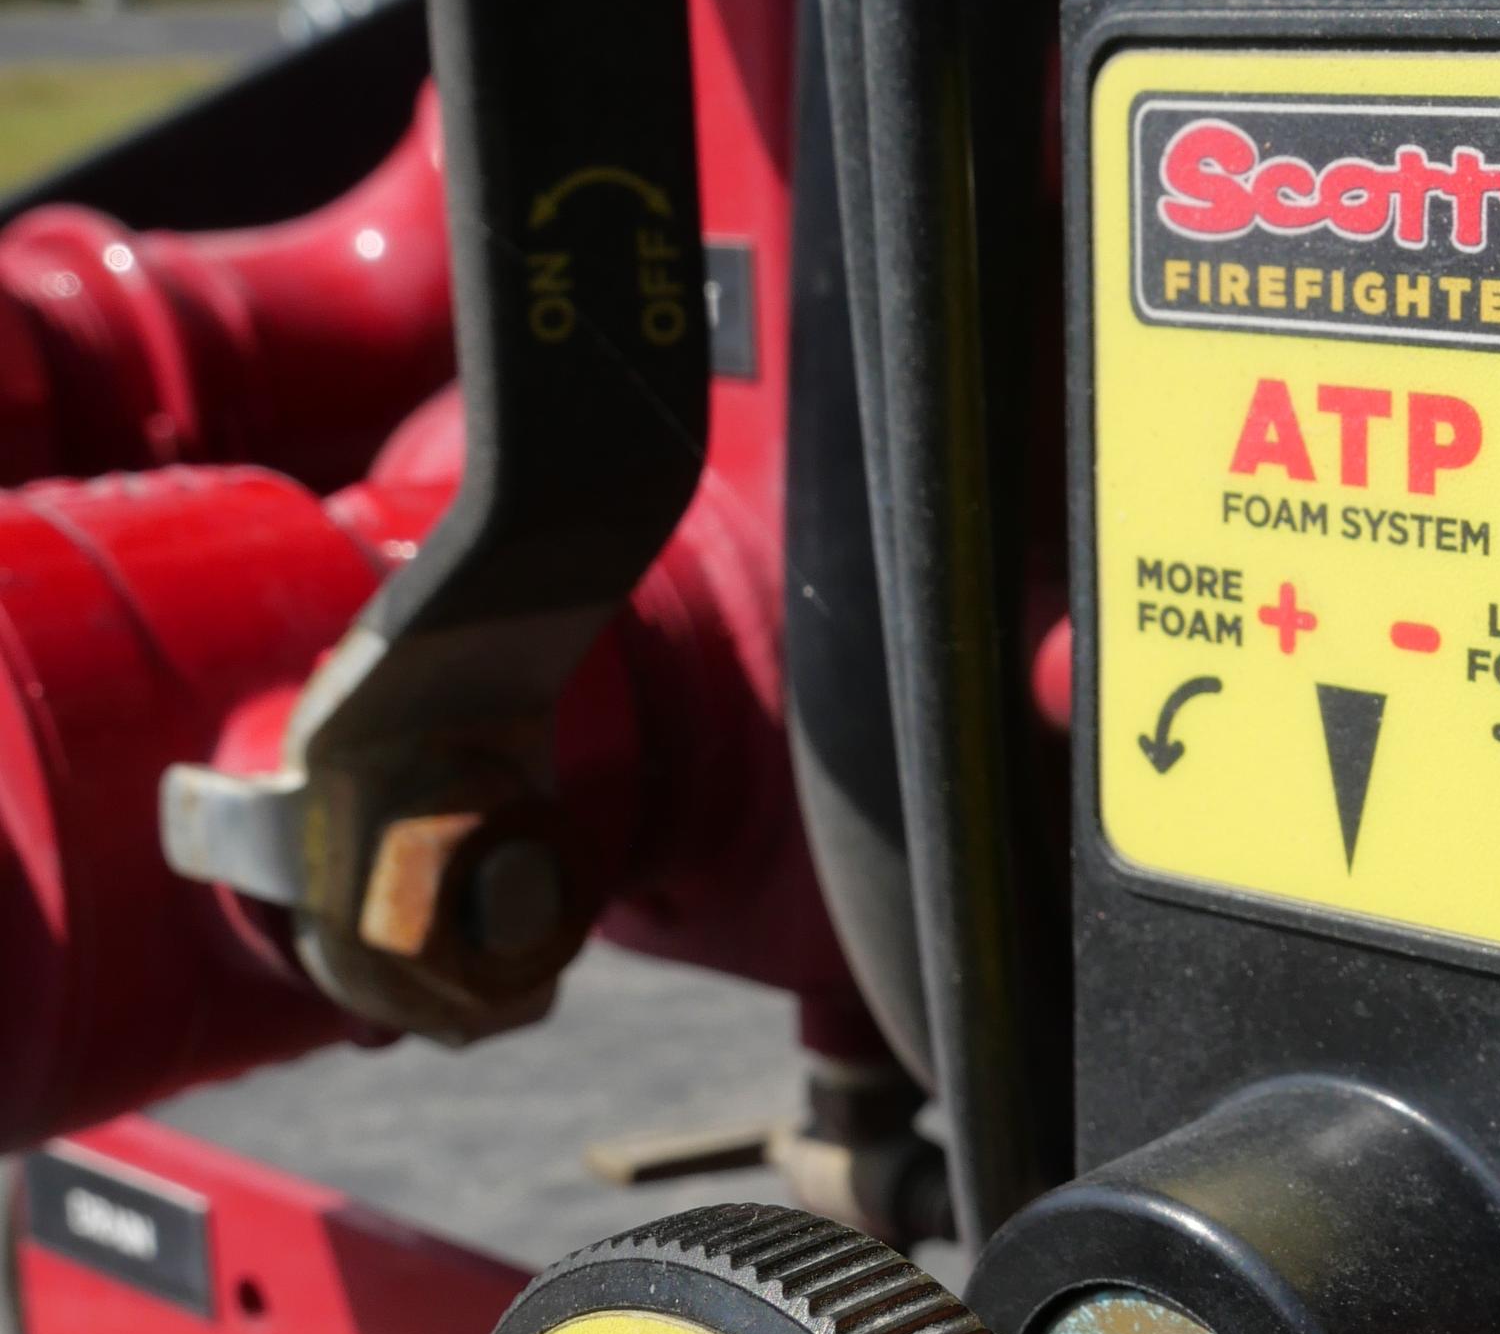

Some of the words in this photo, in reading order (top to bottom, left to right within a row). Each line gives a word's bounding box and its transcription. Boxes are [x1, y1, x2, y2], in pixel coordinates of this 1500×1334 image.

[529, 250, 575, 343] ON
[637, 226, 688, 347] OFF
[1228, 376, 1485, 497] ATP
[1220, 491, 1330, 539] FOAM
[1340, 505, 1492, 557] SYSTEM
[1136, 556, 1244, 604] MORE
[1137, 599, 1244, 649] FOAM
